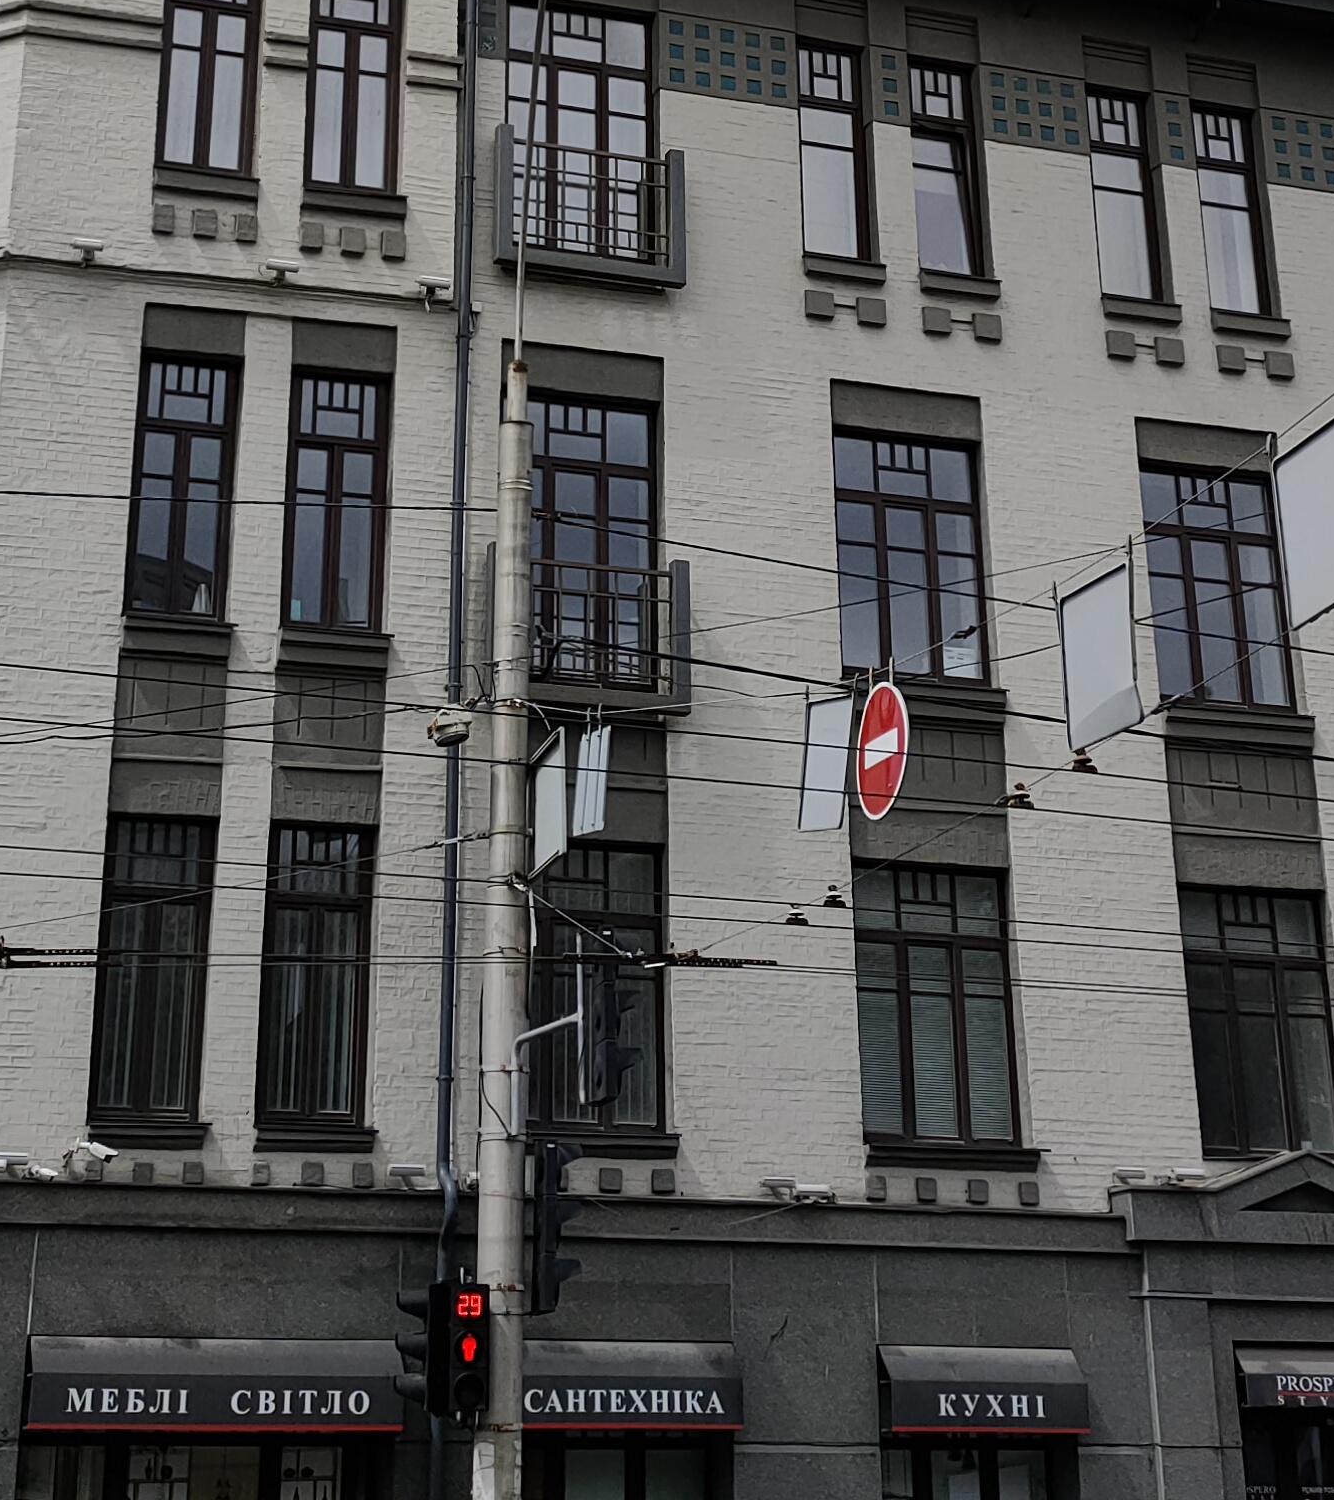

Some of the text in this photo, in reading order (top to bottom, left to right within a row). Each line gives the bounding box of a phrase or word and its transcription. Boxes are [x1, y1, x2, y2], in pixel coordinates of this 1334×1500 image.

[458, 1294, 481, 1316] 29
[65, 1387, 371, 1415] МЕБЛІ СВІТЛО
[523, 1388, 725, 1414] САНТЕХНІКА
[937, 1393, 1046, 1418] КУХНІ
